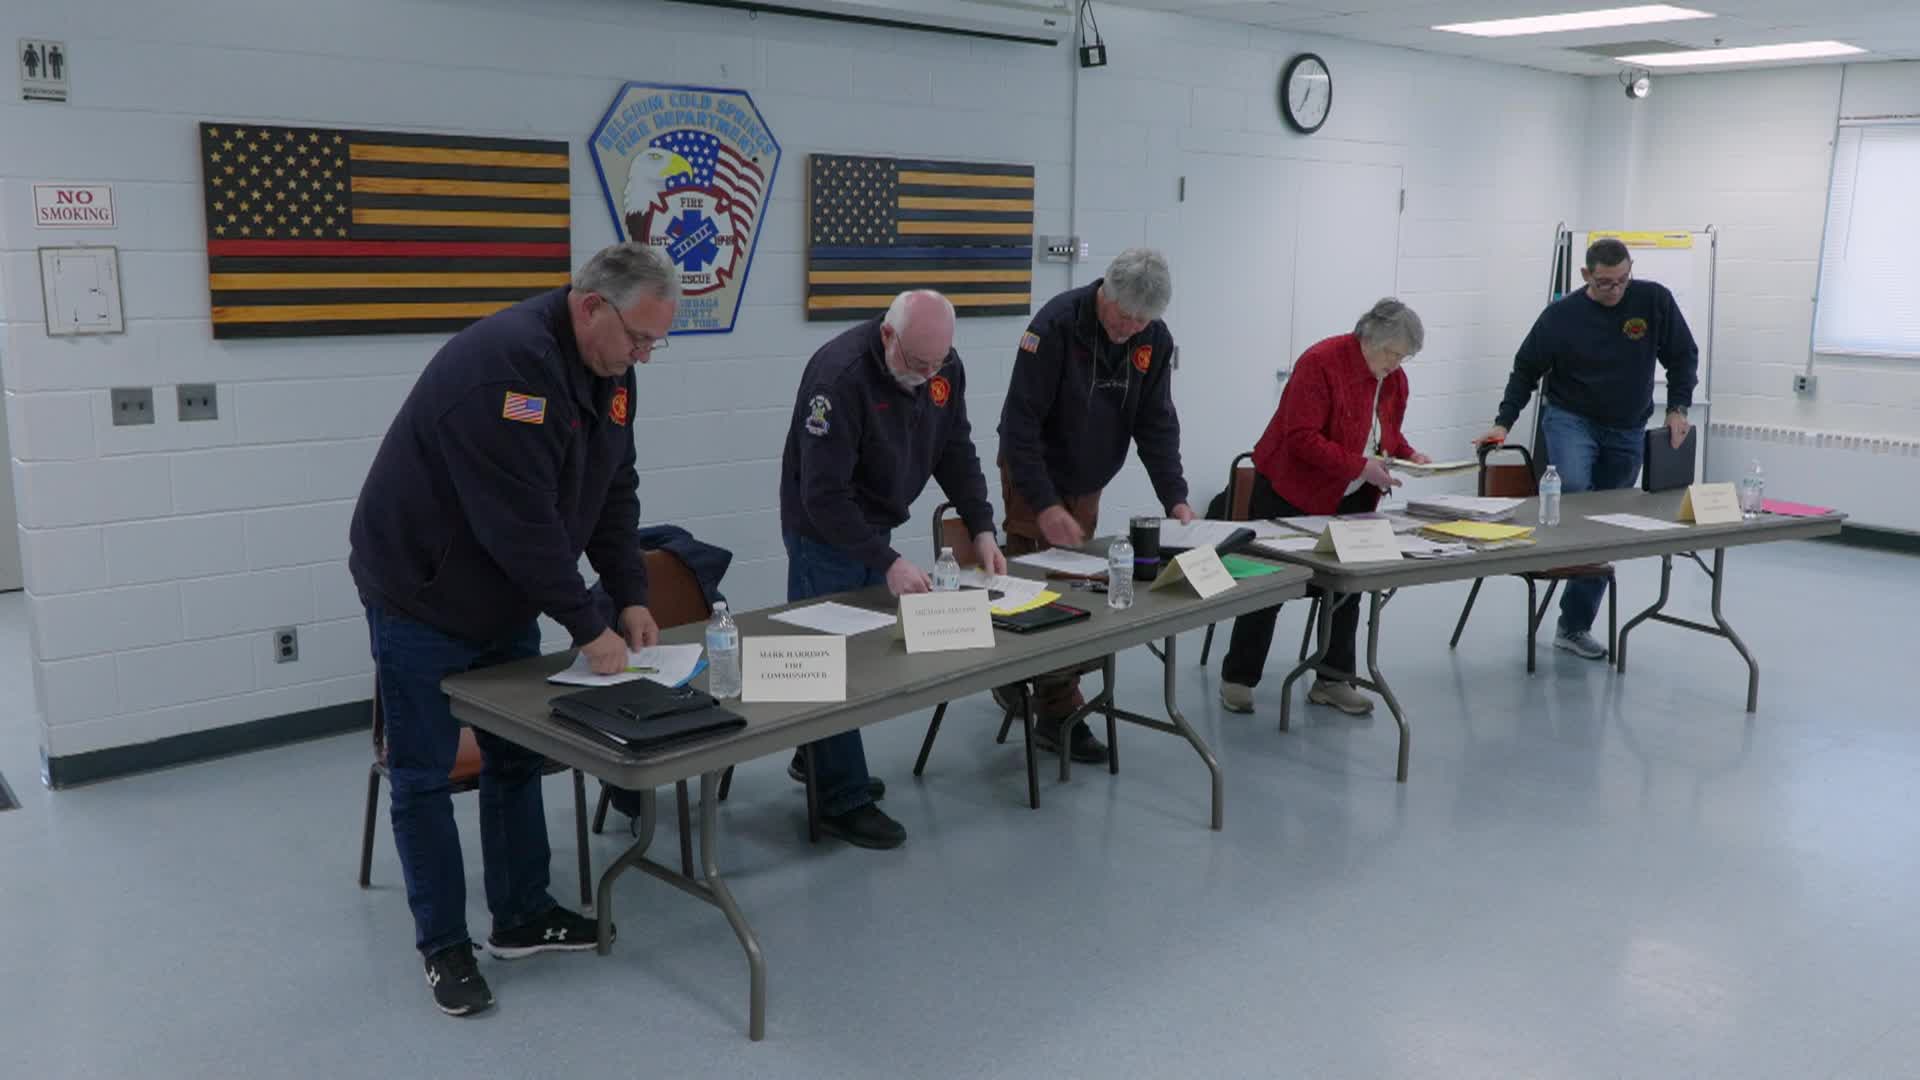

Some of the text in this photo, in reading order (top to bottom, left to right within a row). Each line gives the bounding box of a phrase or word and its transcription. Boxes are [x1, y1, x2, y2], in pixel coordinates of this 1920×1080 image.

[599, 93, 774, 156] BELGIUM COLD SPRINGS
[615, 111, 757, 156] FIRE DEPARTMENT
[56, 190, 93, 204] NO
[680, 197, 704, 208] FIRE
[41, 206, 110, 221] SMOKING
[680, 274, 711, 284] ESCUE
[760, 649, 831, 658] MARK HARRISON
[760, 671, 828, 680] COMMISSIONER
